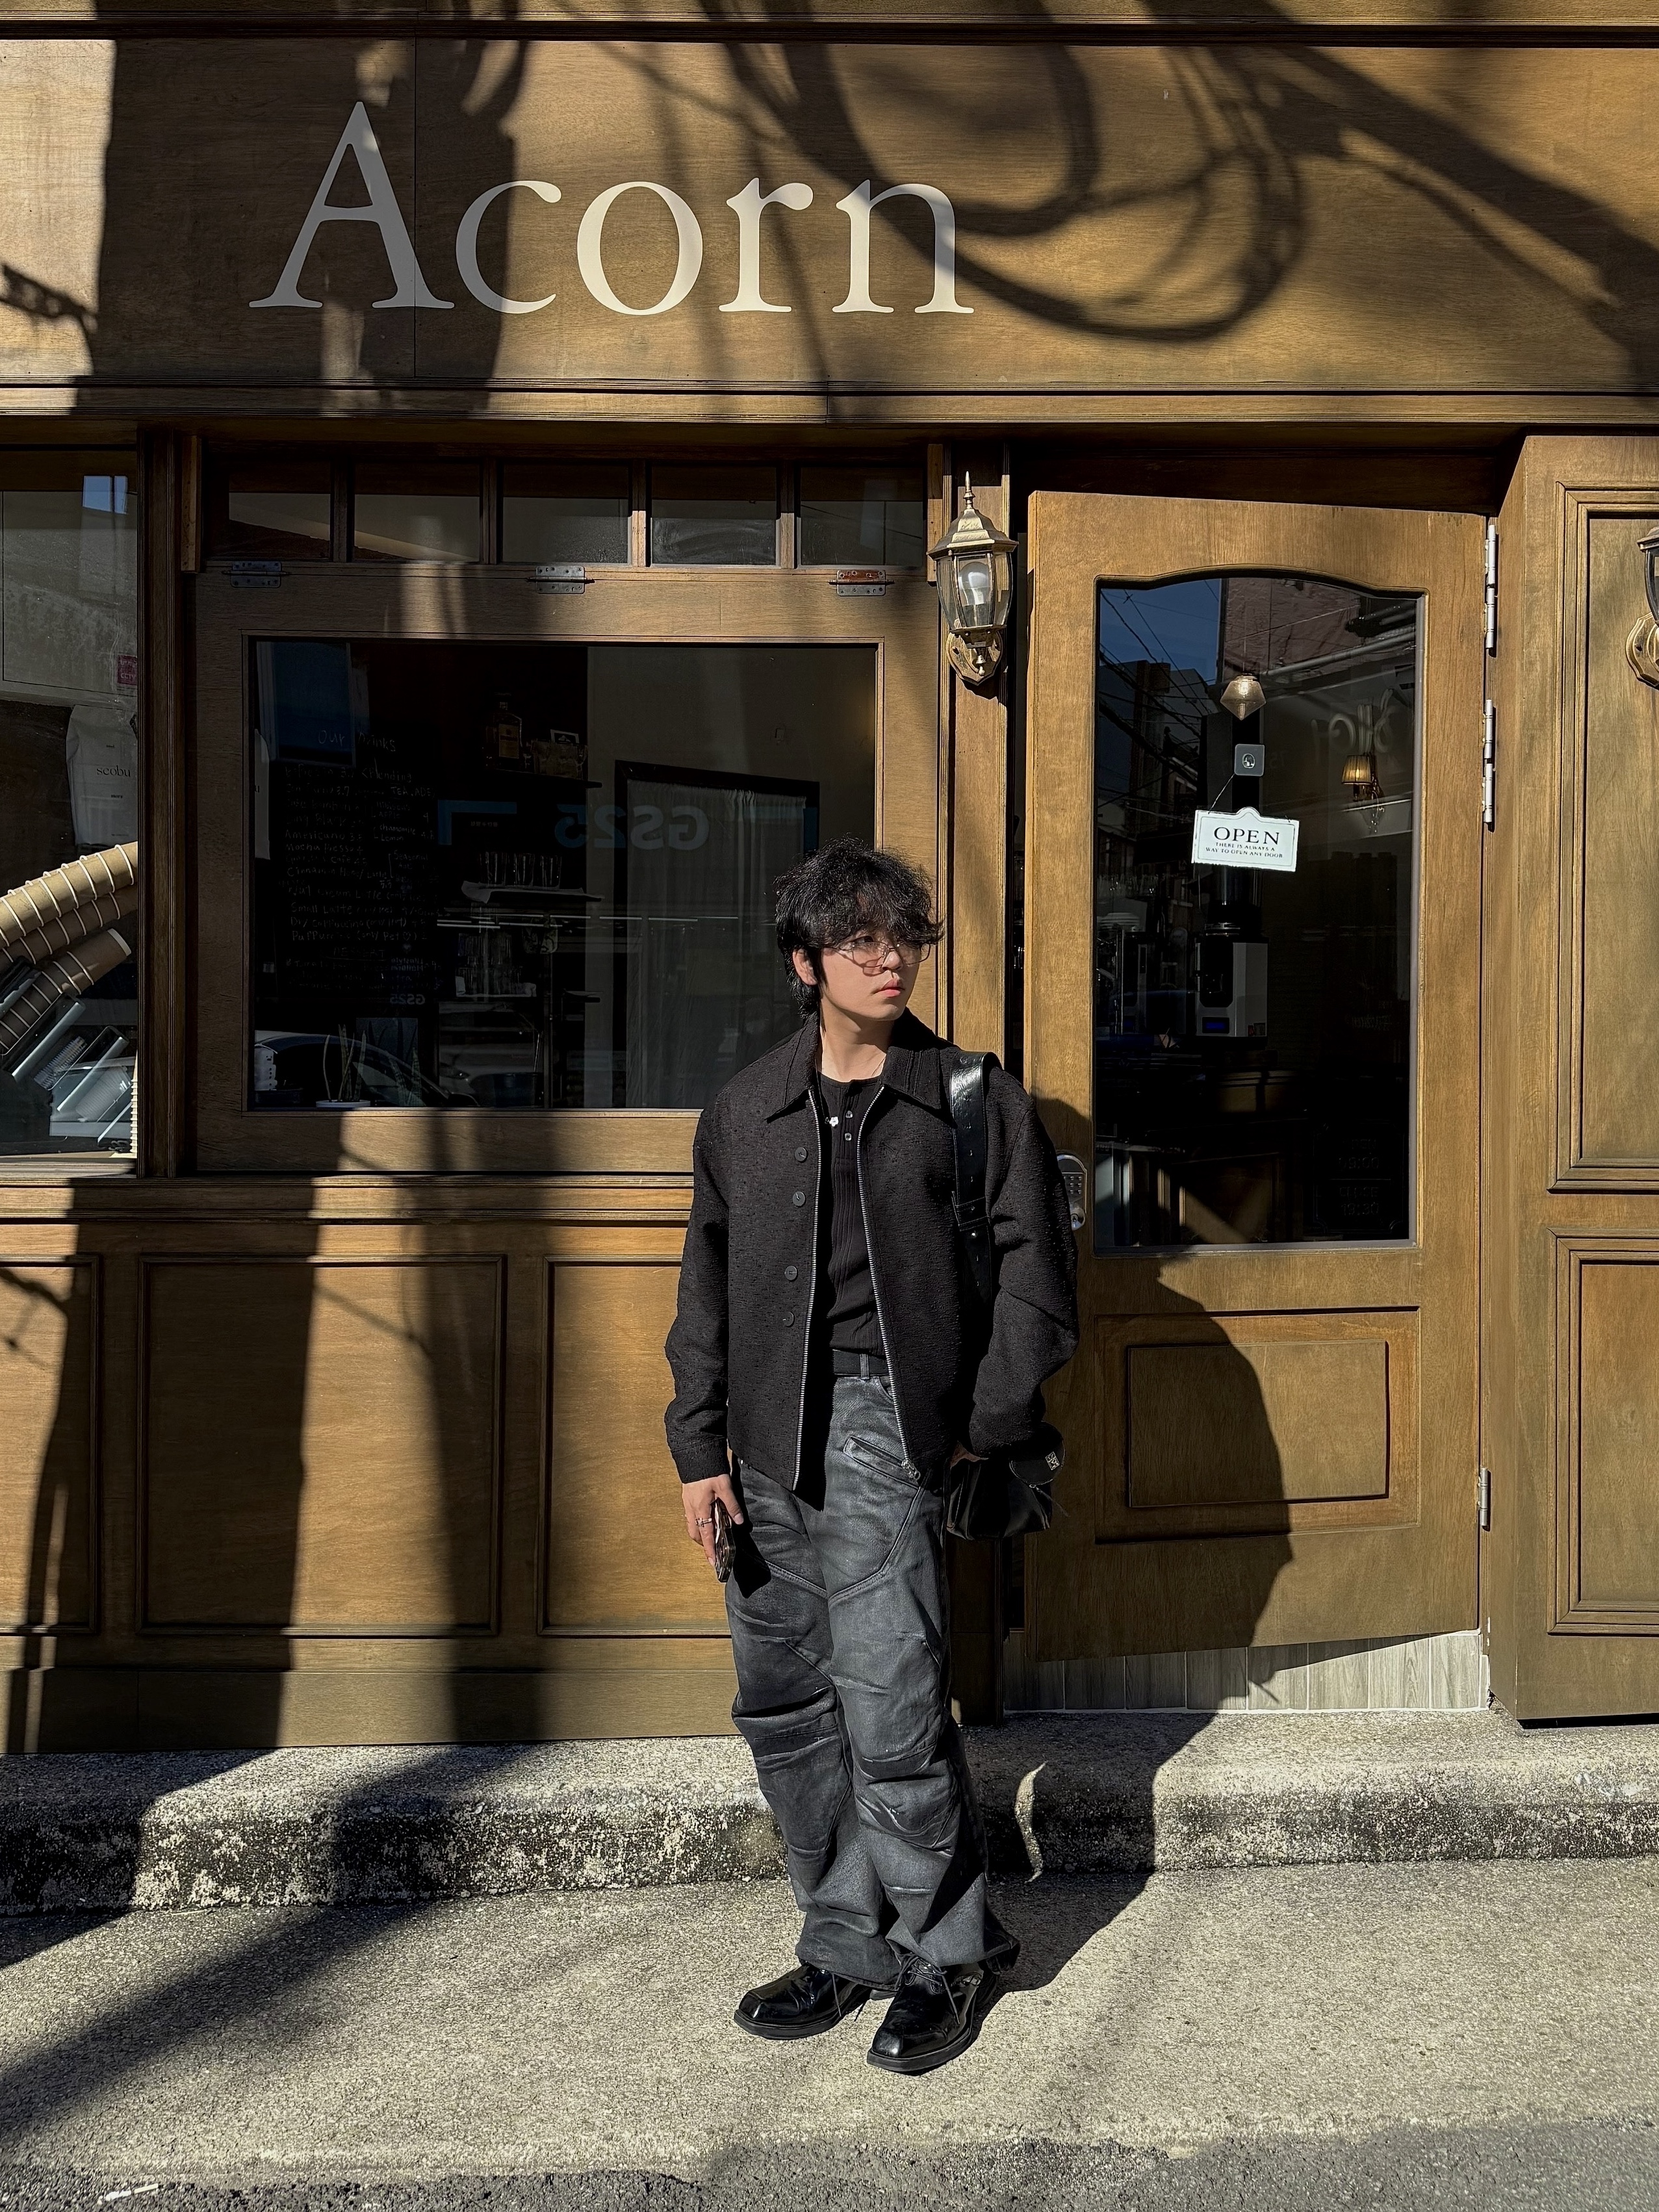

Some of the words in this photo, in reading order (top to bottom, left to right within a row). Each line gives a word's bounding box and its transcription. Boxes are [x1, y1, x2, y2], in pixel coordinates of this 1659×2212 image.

[249, 101, 973, 315] Acorn
[97, 765, 131, 777] scobu
[1214, 827, 1280, 845] OPEN
